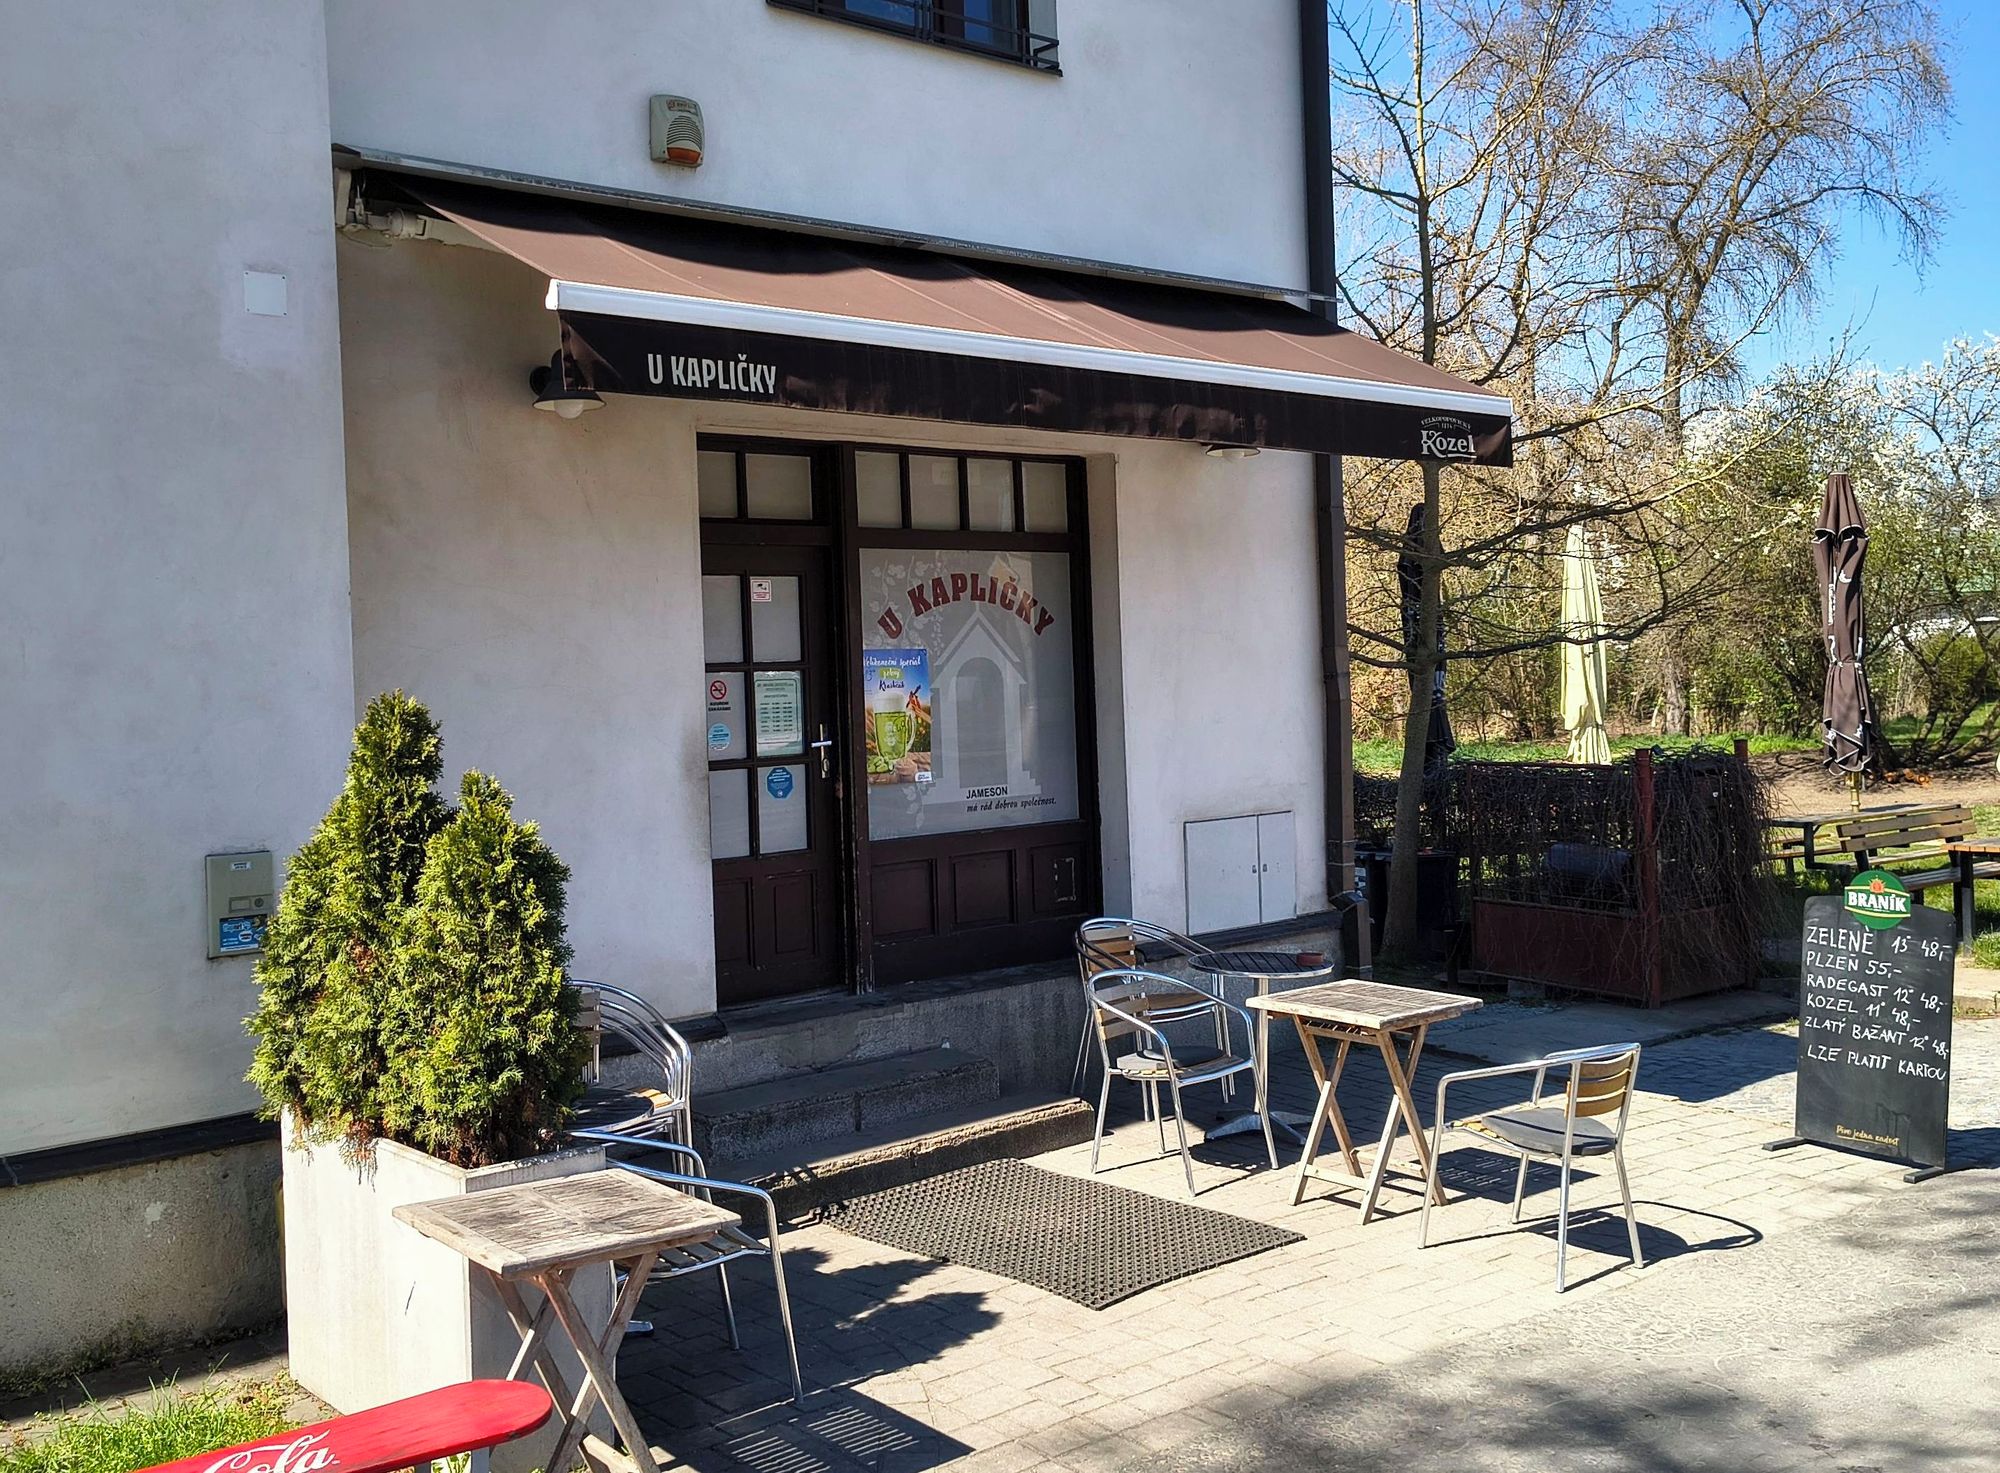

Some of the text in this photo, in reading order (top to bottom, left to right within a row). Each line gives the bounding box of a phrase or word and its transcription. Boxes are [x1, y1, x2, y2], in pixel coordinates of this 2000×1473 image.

[647, 353, 777, 395] U KAPLIČKY
[1421, 430, 1477, 459] Kozel
[877, 573, 1056, 640] U KAPLIČKY
[966, 785, 1009, 800] JAMESON
[995, 799, 1018, 811] dobrou
[1847, 891, 1907, 912] BRANÍK
[1806, 973, 1889, 998] RADEGAST
[1806, 992, 1859, 1014] KOZEL
[1807, 1044, 1947, 1081] LZE PLATIT KARTOU
